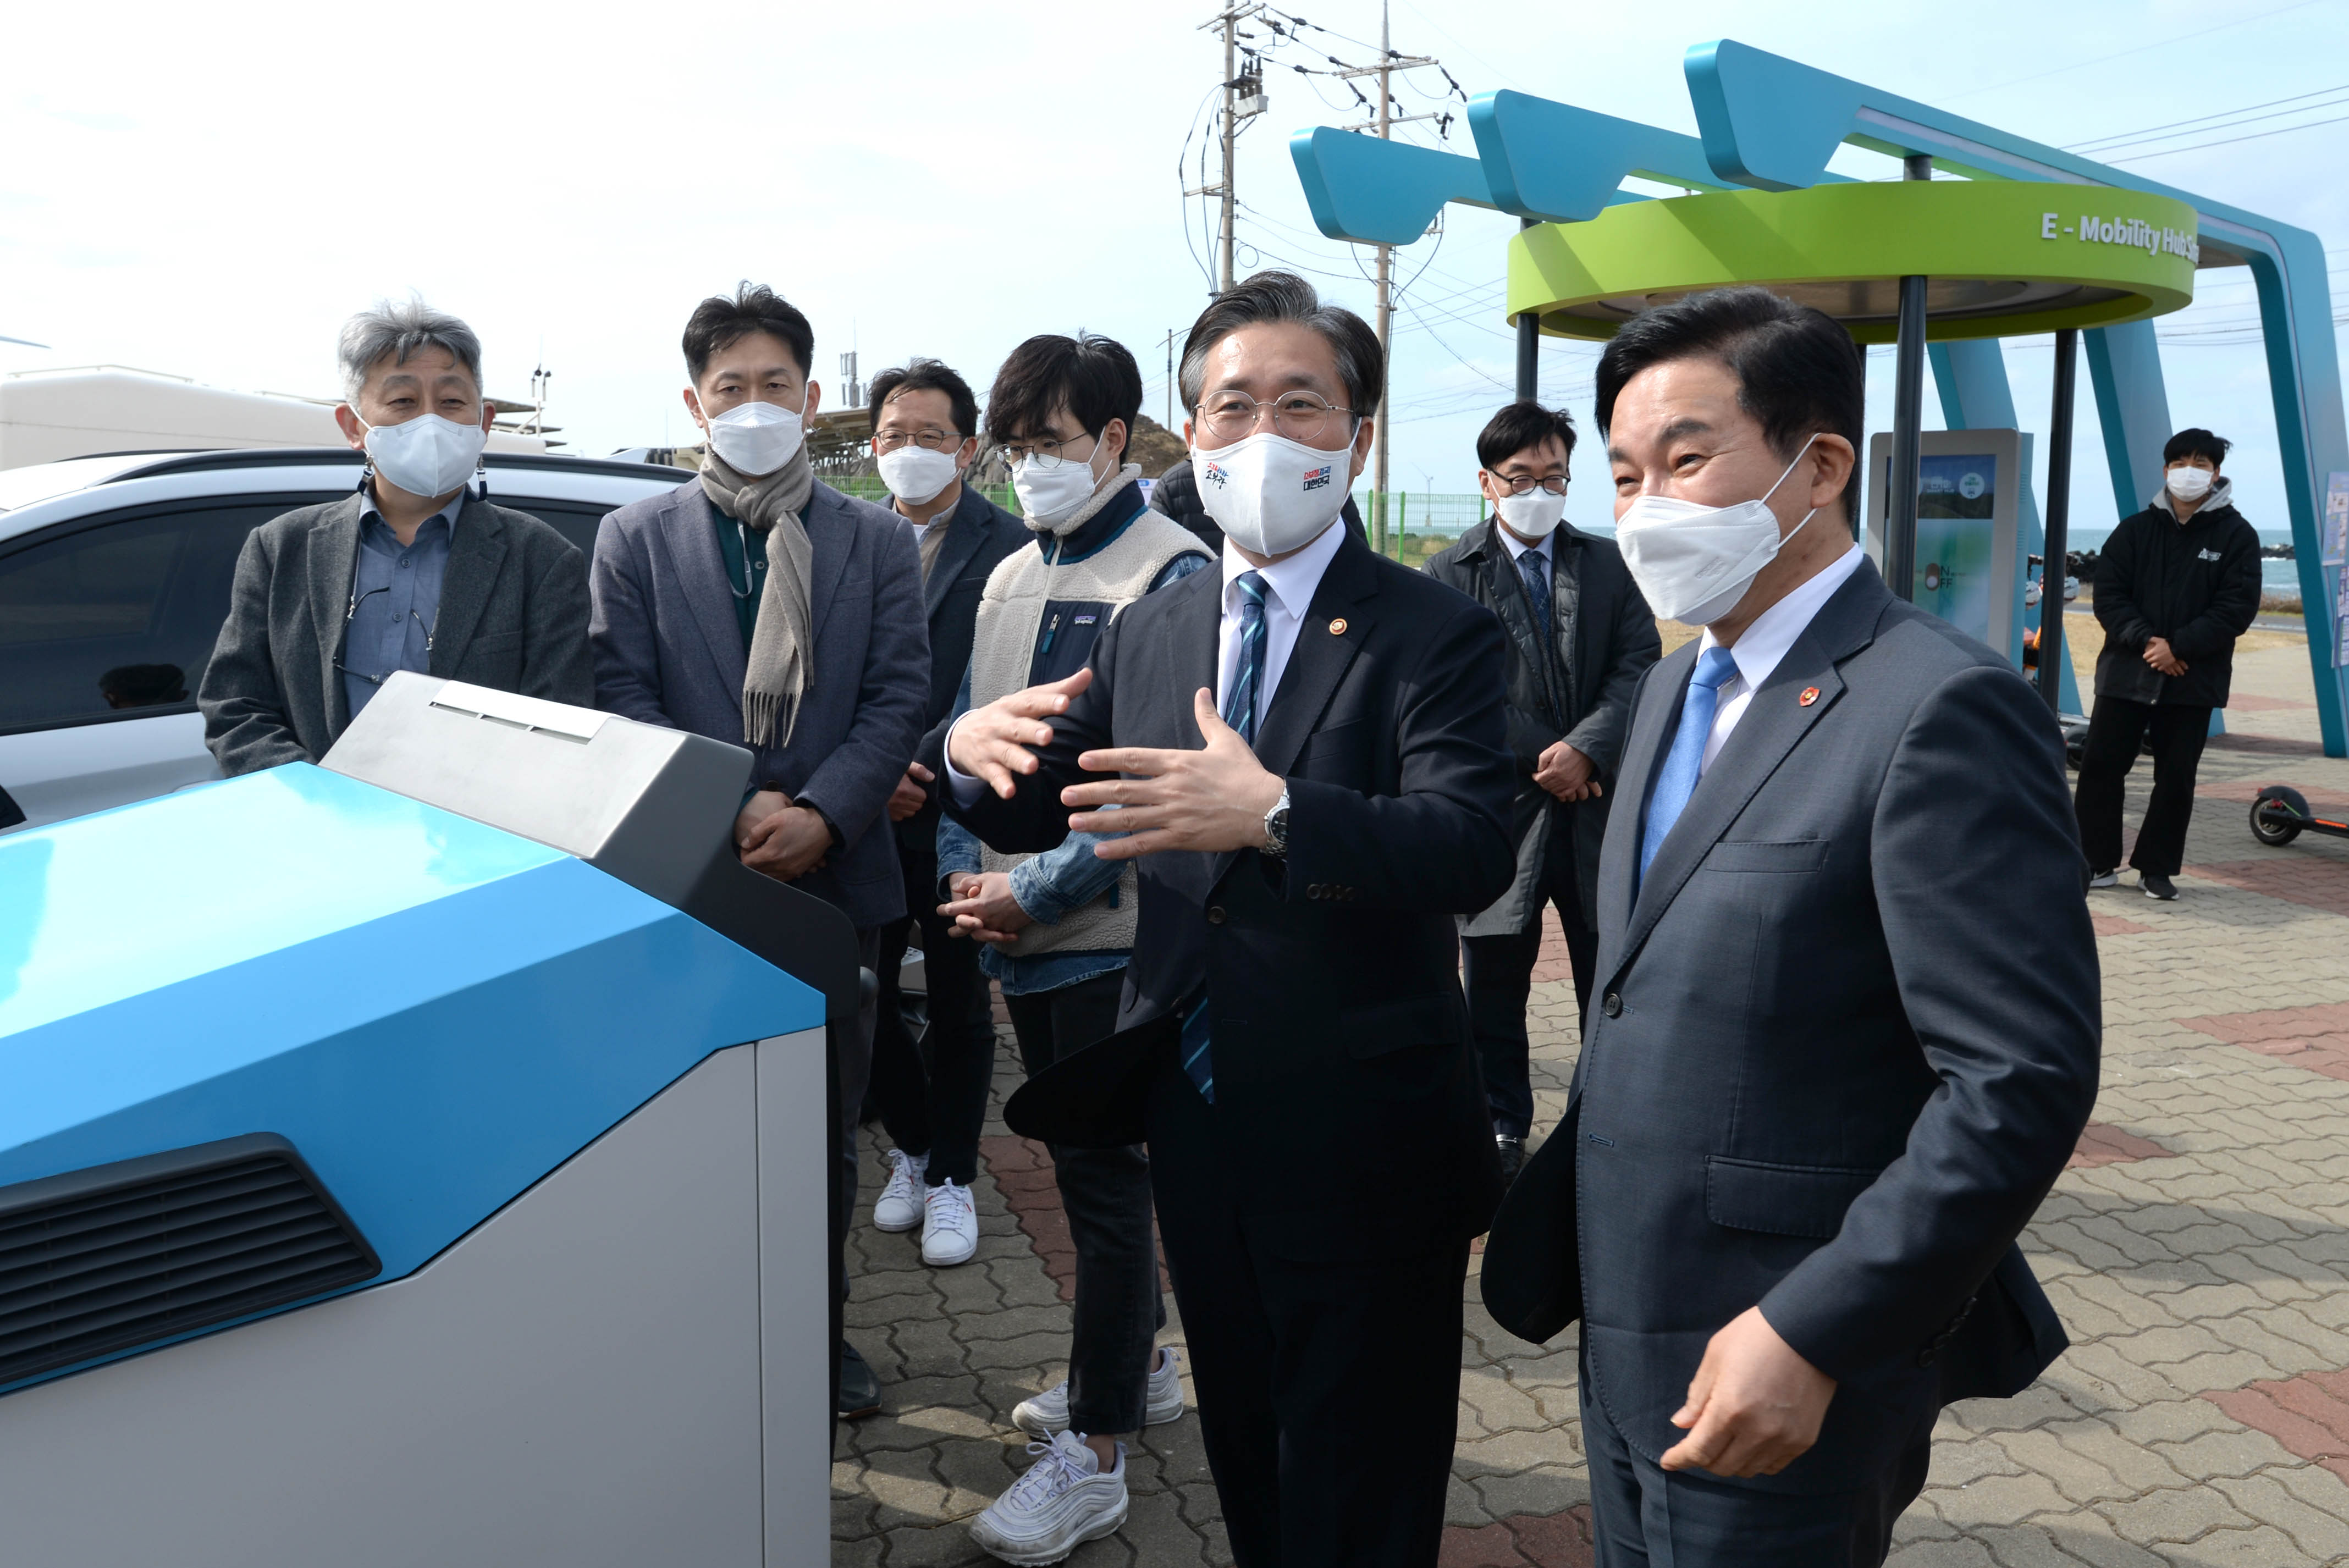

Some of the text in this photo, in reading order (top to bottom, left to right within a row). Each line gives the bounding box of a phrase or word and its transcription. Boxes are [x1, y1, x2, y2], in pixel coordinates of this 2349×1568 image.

[2042, 212, 2058, 239] E
[2079, 216, 2161, 256] Mobility
[2161, 227, 2187, 257] Hub
[1303, 474, 1330, 492] 대한민국
